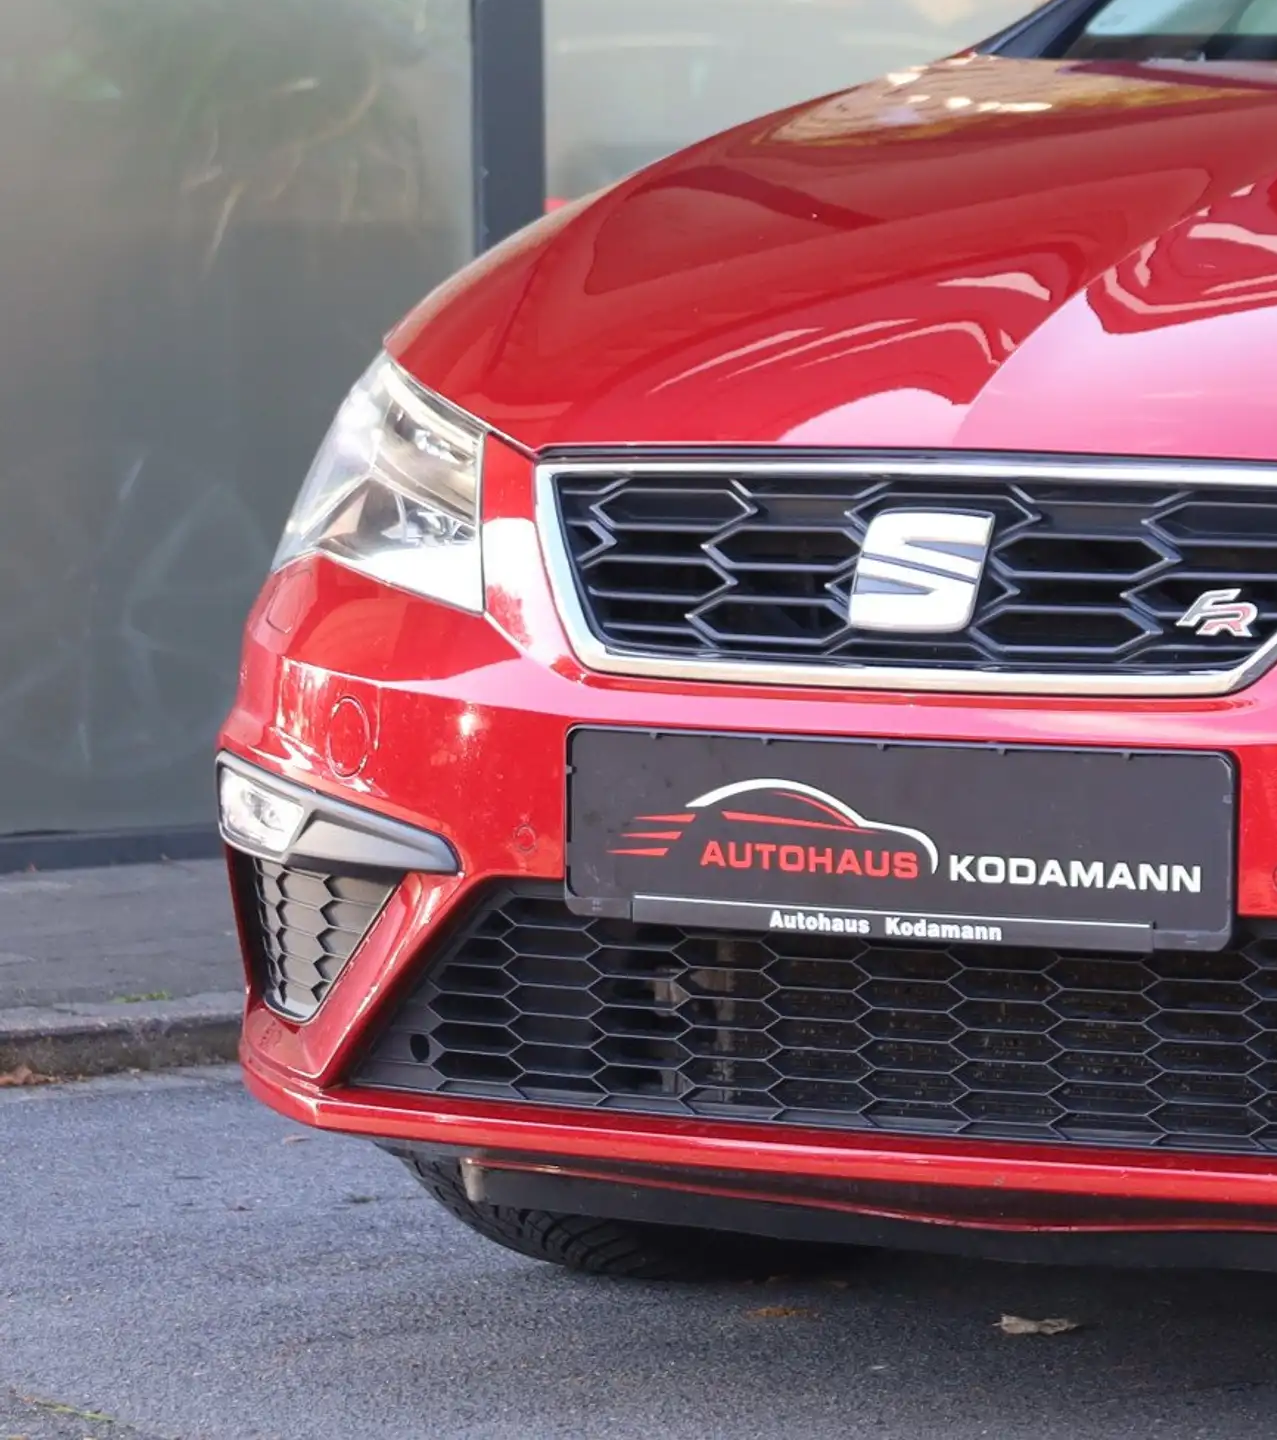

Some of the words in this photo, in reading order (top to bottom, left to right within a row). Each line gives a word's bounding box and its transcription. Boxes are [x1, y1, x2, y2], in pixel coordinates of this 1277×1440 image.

[700, 841, 919, 879] AUTOHAUS
[949, 855, 1201, 893] KODAMANN
[769, 910, 870, 934] Autohaus
[885, 916, 1002, 941] Kodamann
